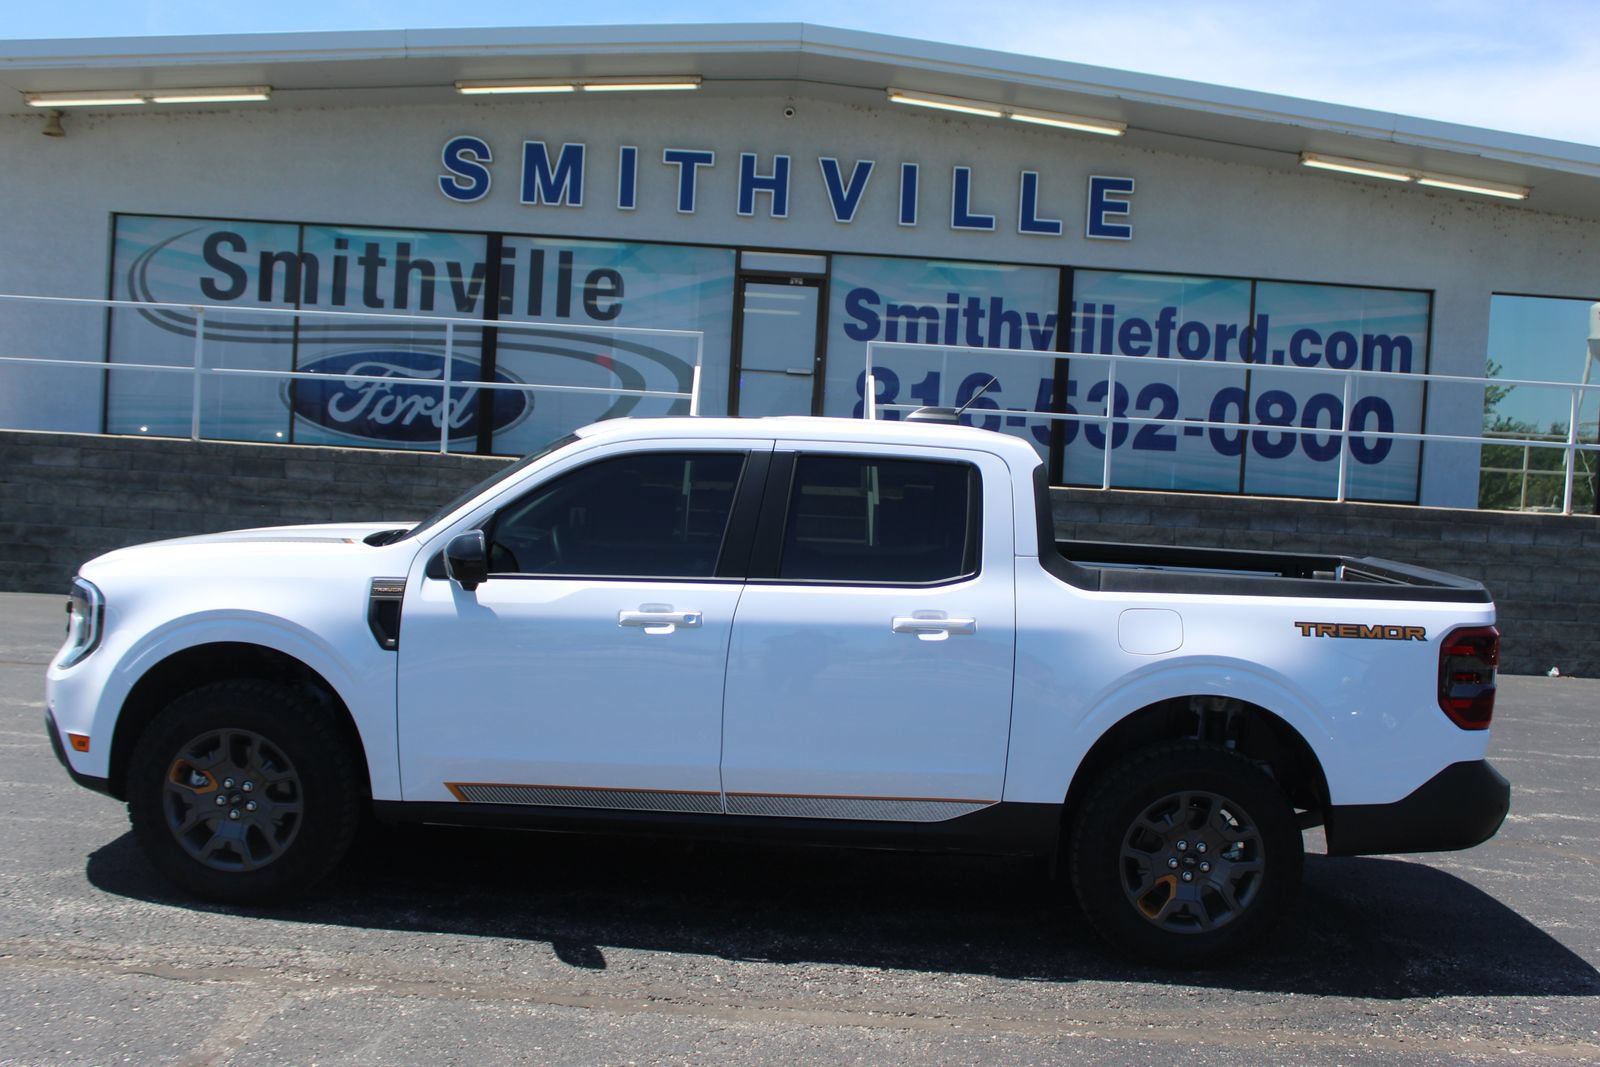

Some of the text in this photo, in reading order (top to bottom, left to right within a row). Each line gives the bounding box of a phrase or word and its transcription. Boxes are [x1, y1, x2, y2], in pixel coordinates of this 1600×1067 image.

[438, 135, 1135, 240] SMITHVILLE
[200, 231, 625, 321] Smithville
[328, 361, 477, 429] Ford
[1294, 621, 1428, 641] TREMOR
